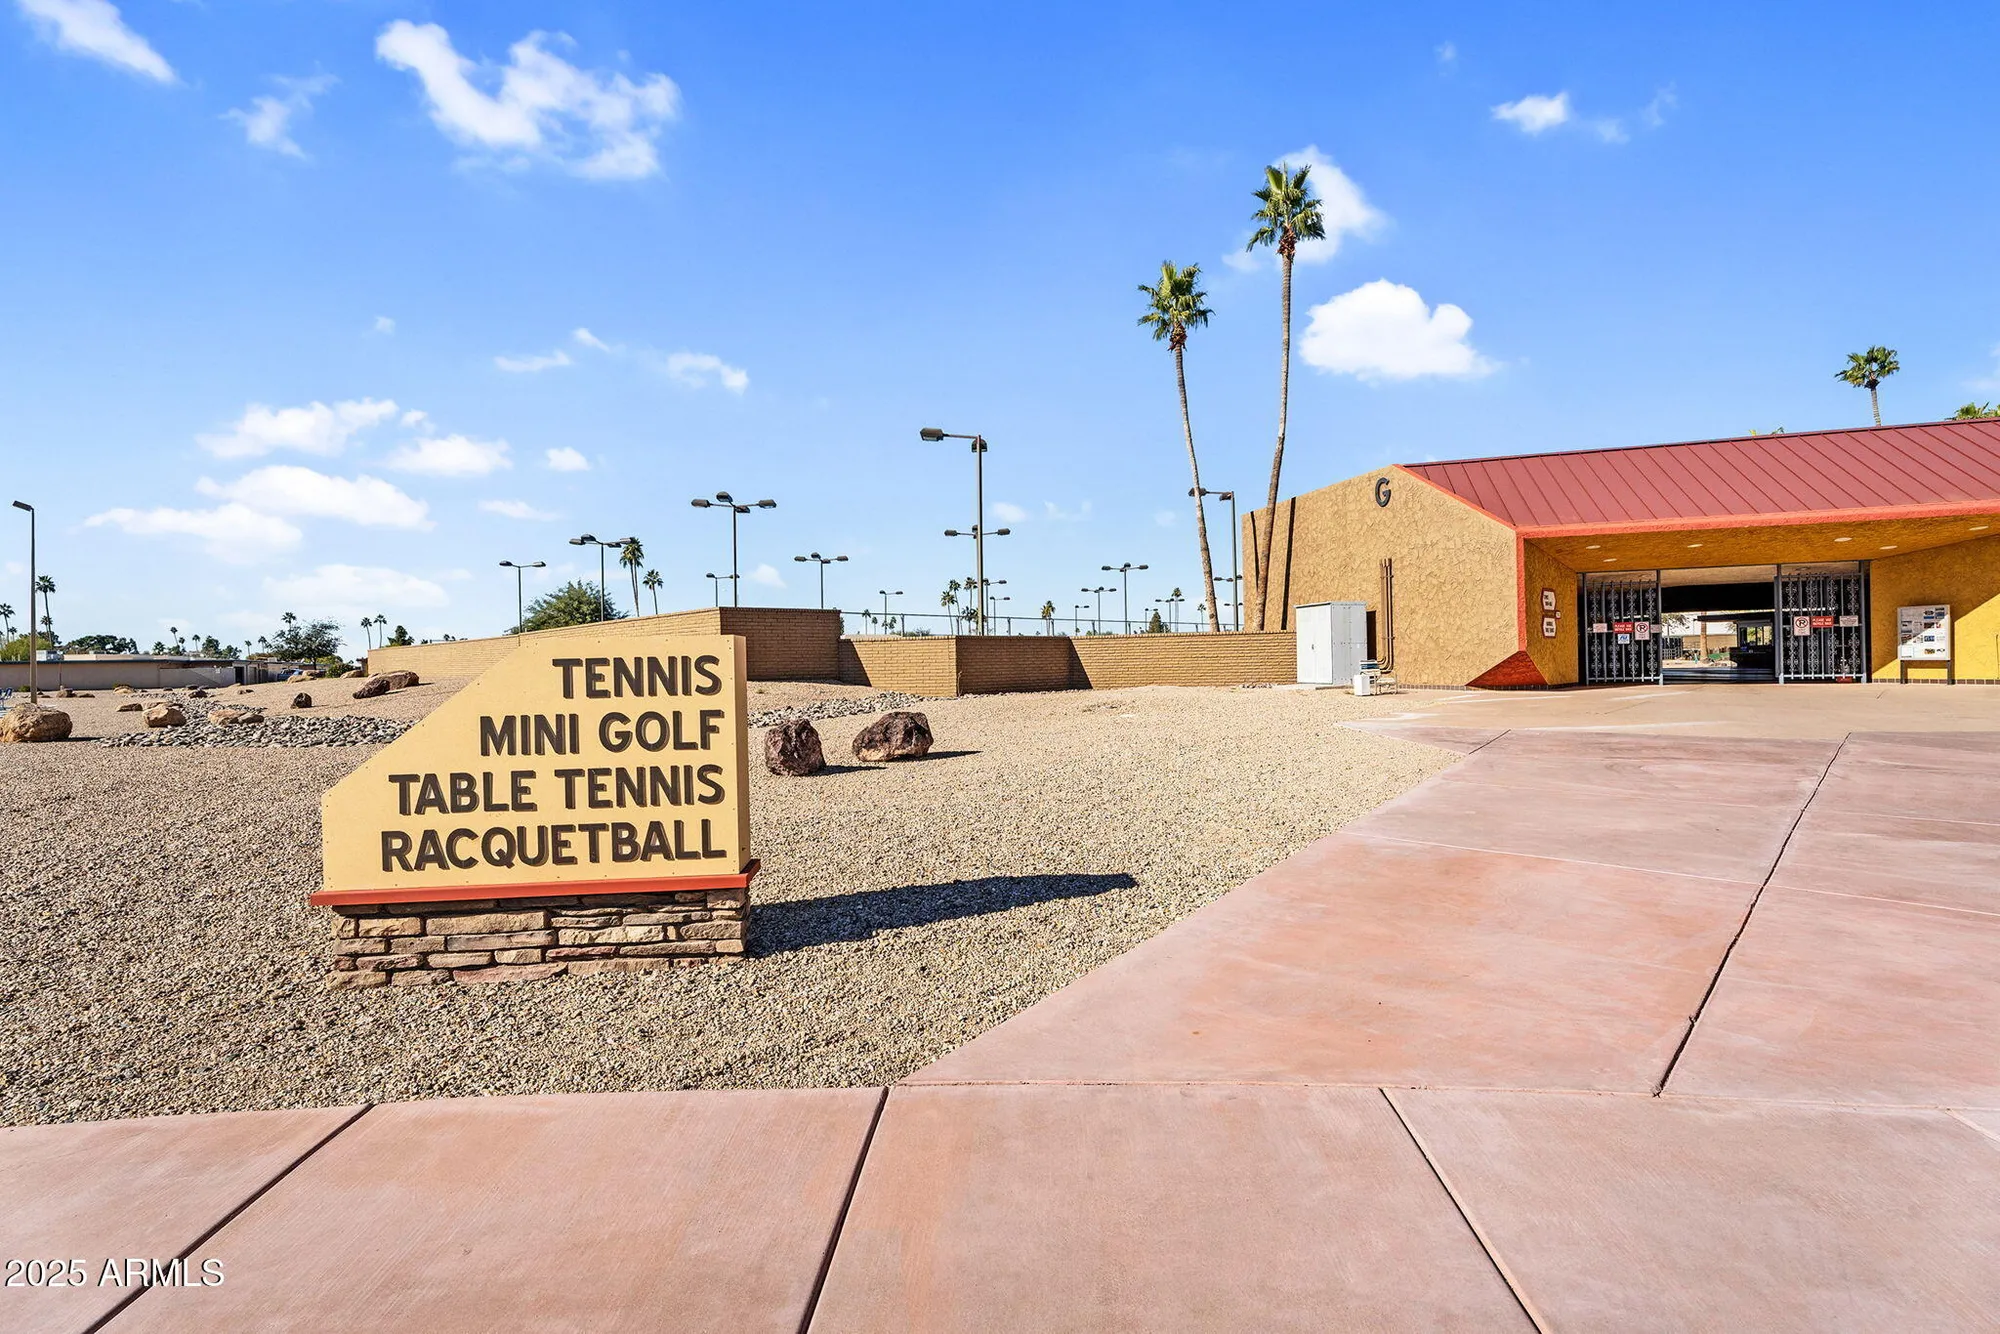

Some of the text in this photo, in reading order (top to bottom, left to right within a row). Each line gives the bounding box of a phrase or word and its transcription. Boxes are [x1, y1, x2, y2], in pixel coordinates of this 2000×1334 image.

[1375, 477, 1391, 507] G
[552, 654, 723, 700] TENNIS
[480, 709, 725, 757] MINI GOLF
[388, 764, 726, 817] TABLE TENNIS
[381, 818, 728, 873] RACQUETBALL
